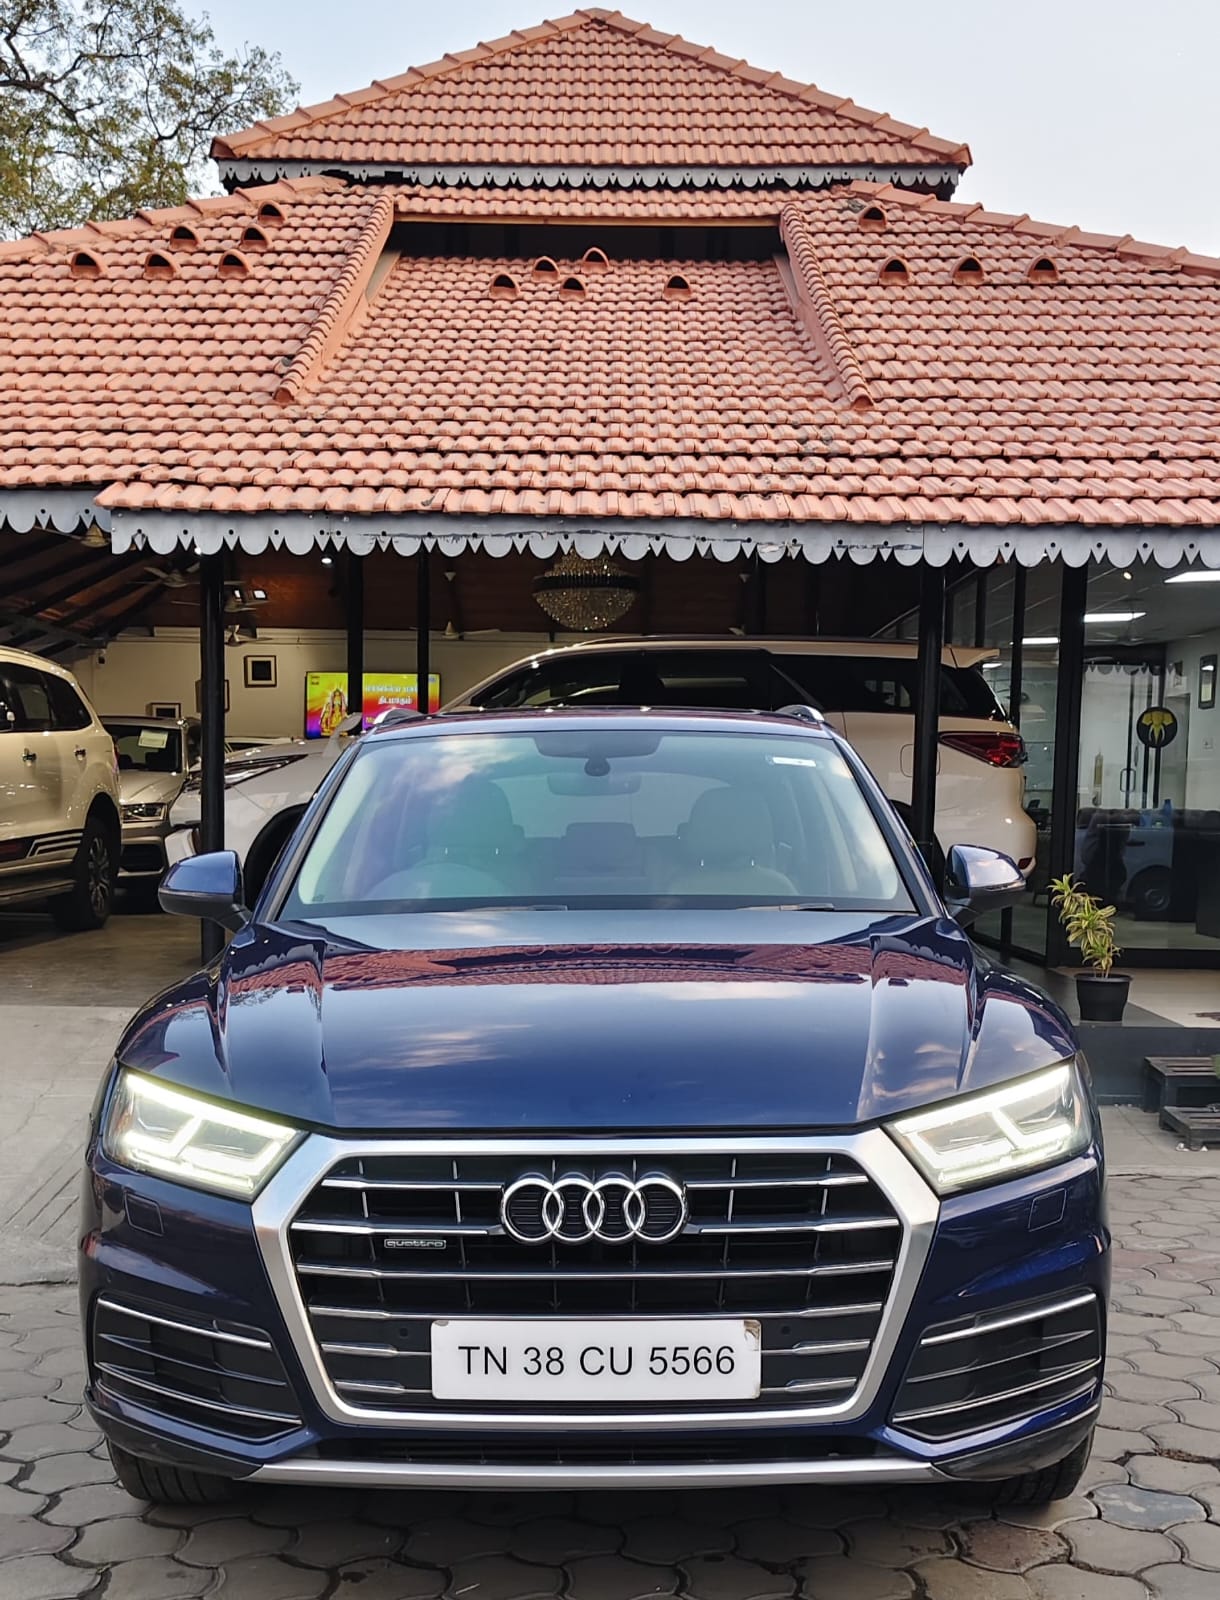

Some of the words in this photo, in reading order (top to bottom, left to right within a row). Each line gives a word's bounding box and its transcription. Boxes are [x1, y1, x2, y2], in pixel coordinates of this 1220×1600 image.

[386, 1239, 444, 1248] quattro
[458, 1345, 507, 1375] TN
[523, 1345, 565, 1376] 38
[579, 1345, 633, 1376] CU
[648, 1345, 735, 1375] 5566
